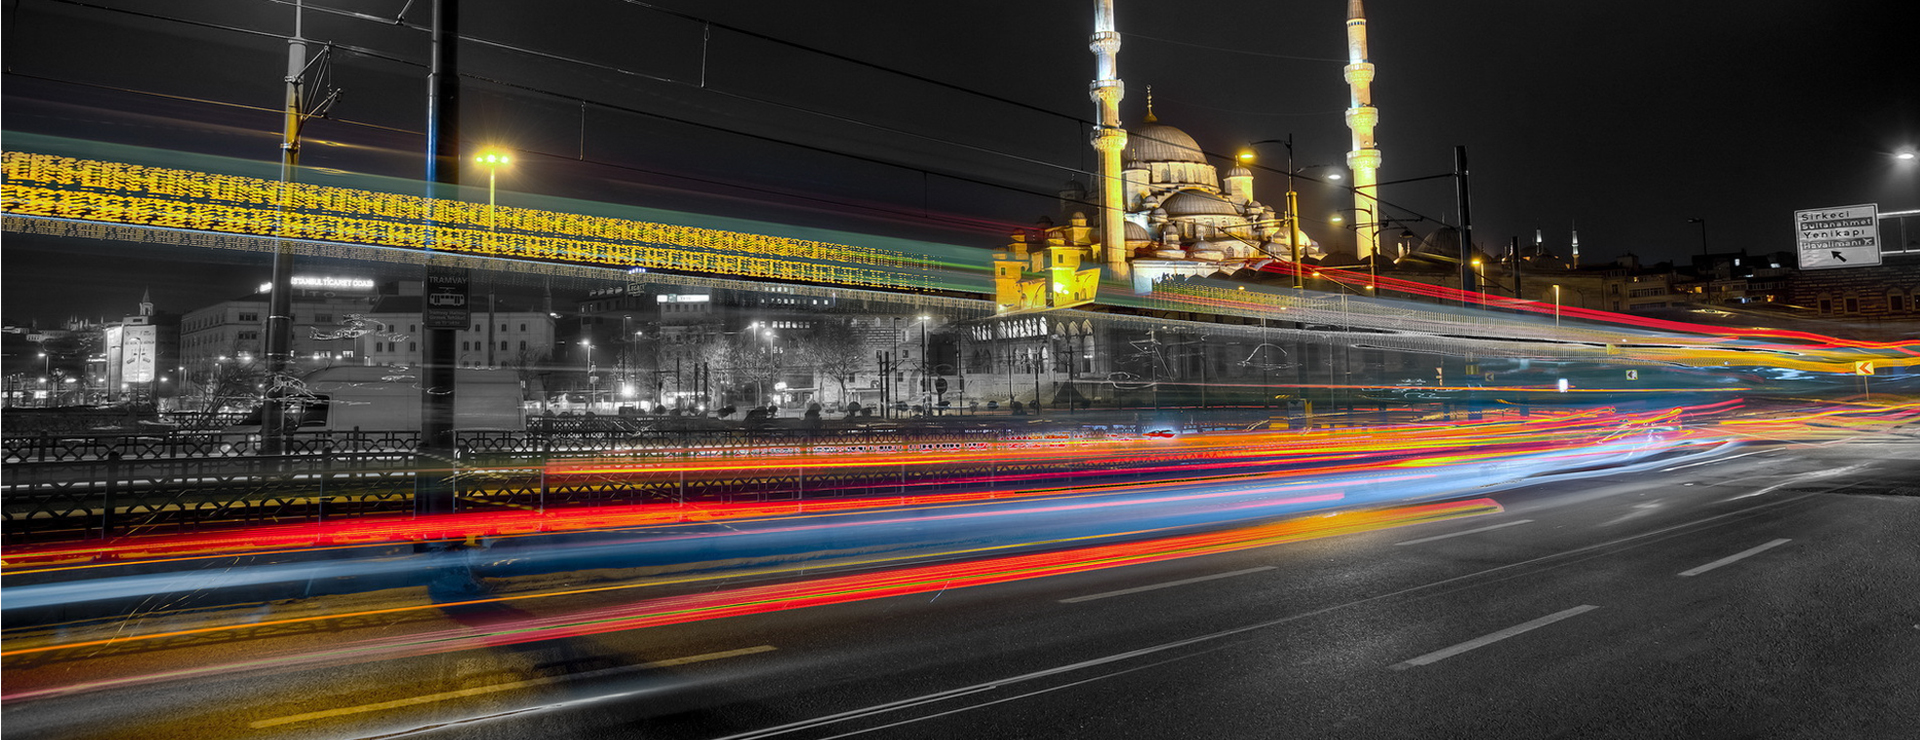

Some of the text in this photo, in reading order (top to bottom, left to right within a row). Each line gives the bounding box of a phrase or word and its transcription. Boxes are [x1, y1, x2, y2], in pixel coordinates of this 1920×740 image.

[1801, 211, 1850, 221] Sirkeci
[1801, 218, 1872, 230] Sultanahmet
[1803, 229, 1865, 239] Yenikapı
[1803, 240, 1861, 250] Havalimanı
[429, 276, 468, 284] TRAMVAY
